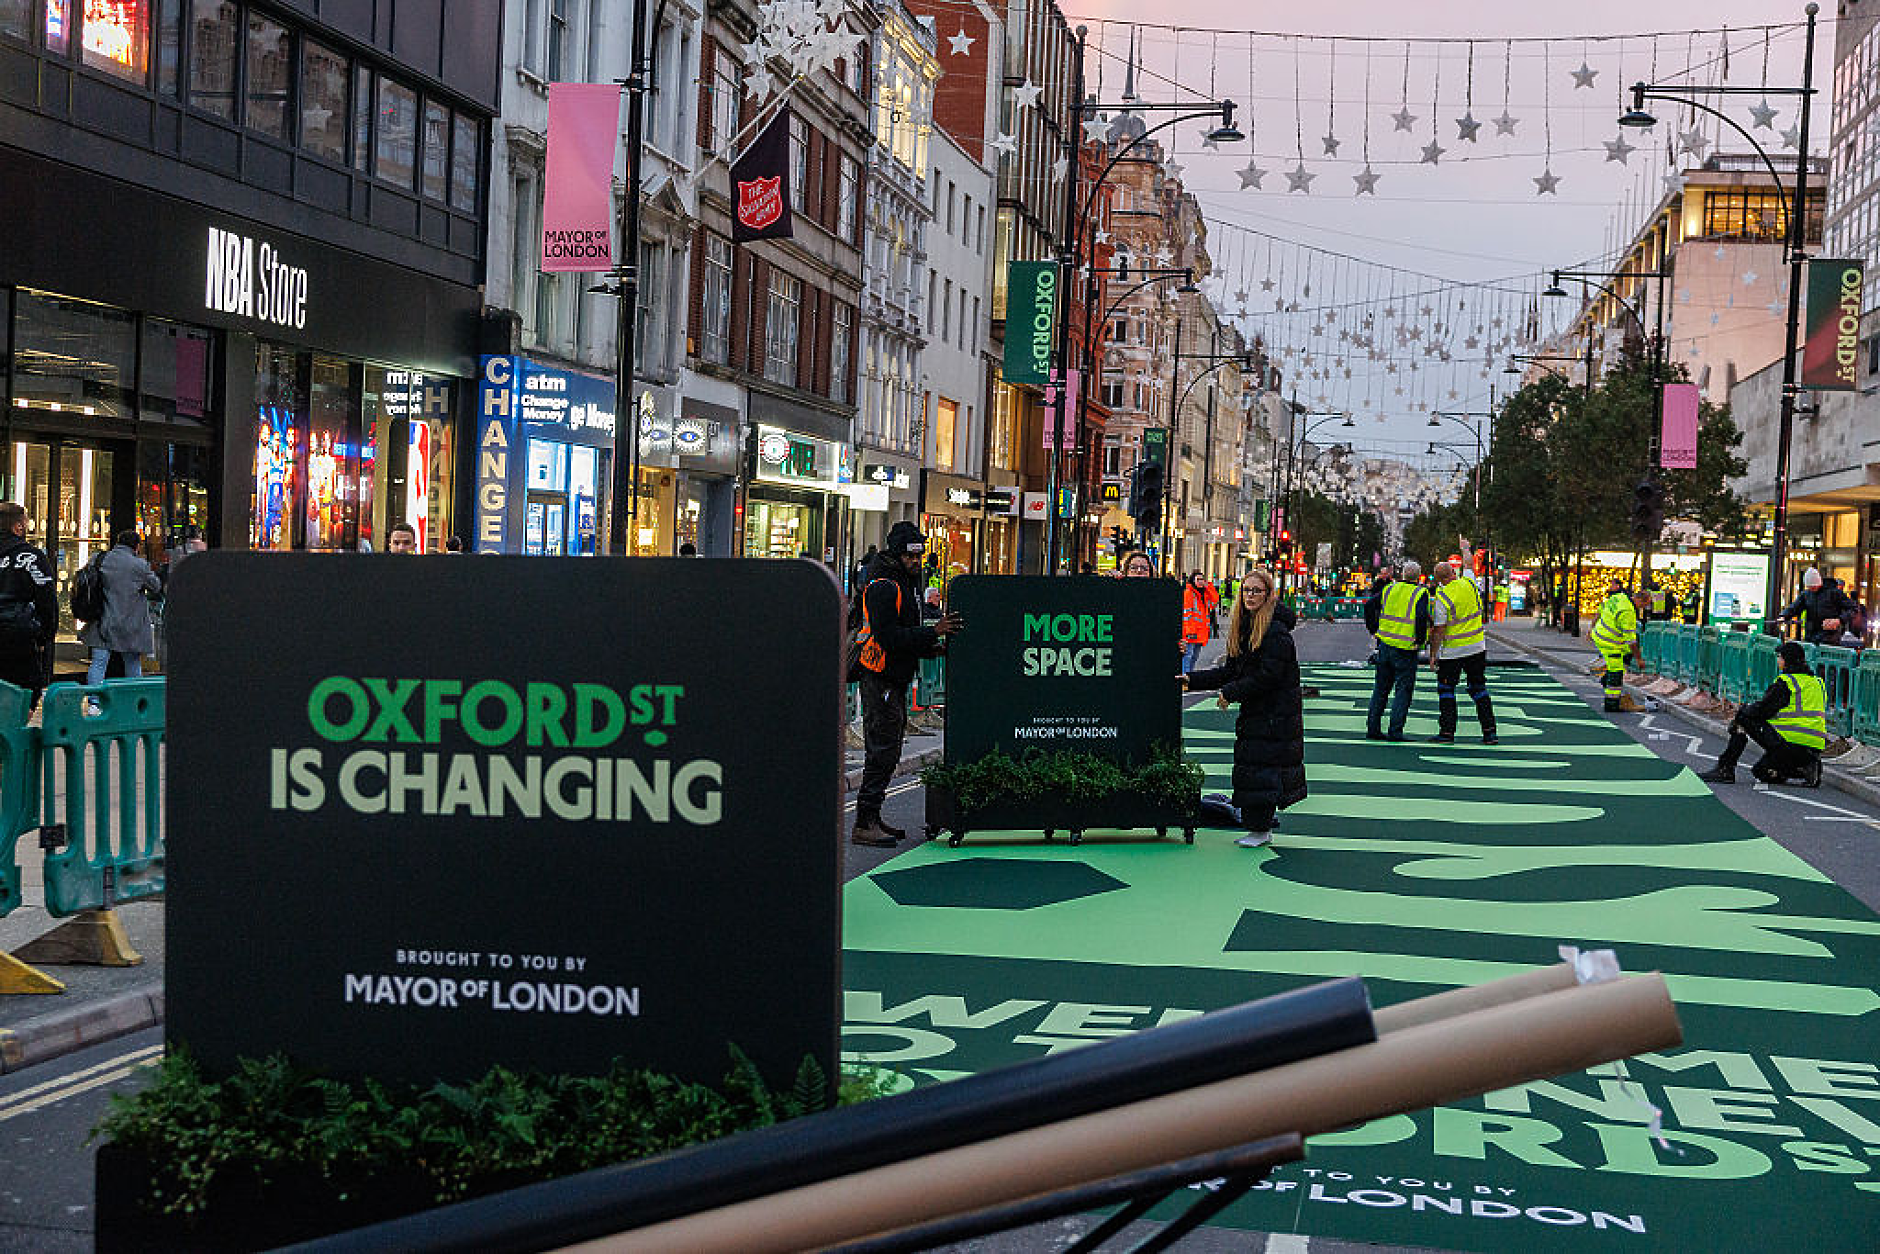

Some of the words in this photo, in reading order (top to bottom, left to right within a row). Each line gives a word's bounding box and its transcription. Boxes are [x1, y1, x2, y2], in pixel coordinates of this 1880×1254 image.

[545, 231, 593, 243] MAYOR
[545, 244, 609, 257] LONDON
[206, 227, 253, 317] NBA
[257, 242, 308, 329] Store
[1033, 271, 1056, 360] OXFORD
[1837, 268, 1862, 366] OXFORD
[525, 374, 567, 392] atm
[521, 394, 569, 409] Change
[523, 407, 566, 423] Money
[480, 357, 511, 543] CHANGE
[1023, 613, 1114, 642] MORE
[1022, 647, 1113, 676] SPACE
[308, 676, 627, 748] OXFORD
[1014, 726, 1056, 738] MAYOR
[1066, 727, 1118, 738] LONDON
[270, 747, 326, 812] IS
[338, 750, 723, 825] CHANGING
[396, 949, 482, 968] BROUGHT
[489, 953, 513, 968] TO
[521, 956, 557, 971] YOU
[565, 956, 587, 971] BY
[345, 974, 458, 1007] MAYOR
[460, 980, 489, 999] OF
[492, 981, 640, 1016] LONDON
[1303, 1169, 1353, 1181] TO
[1375, 1175, 1454, 1191] YOU
[1474, 1185, 1516, 1197] BY
[1308, 1183, 1647, 1234] LONDON
